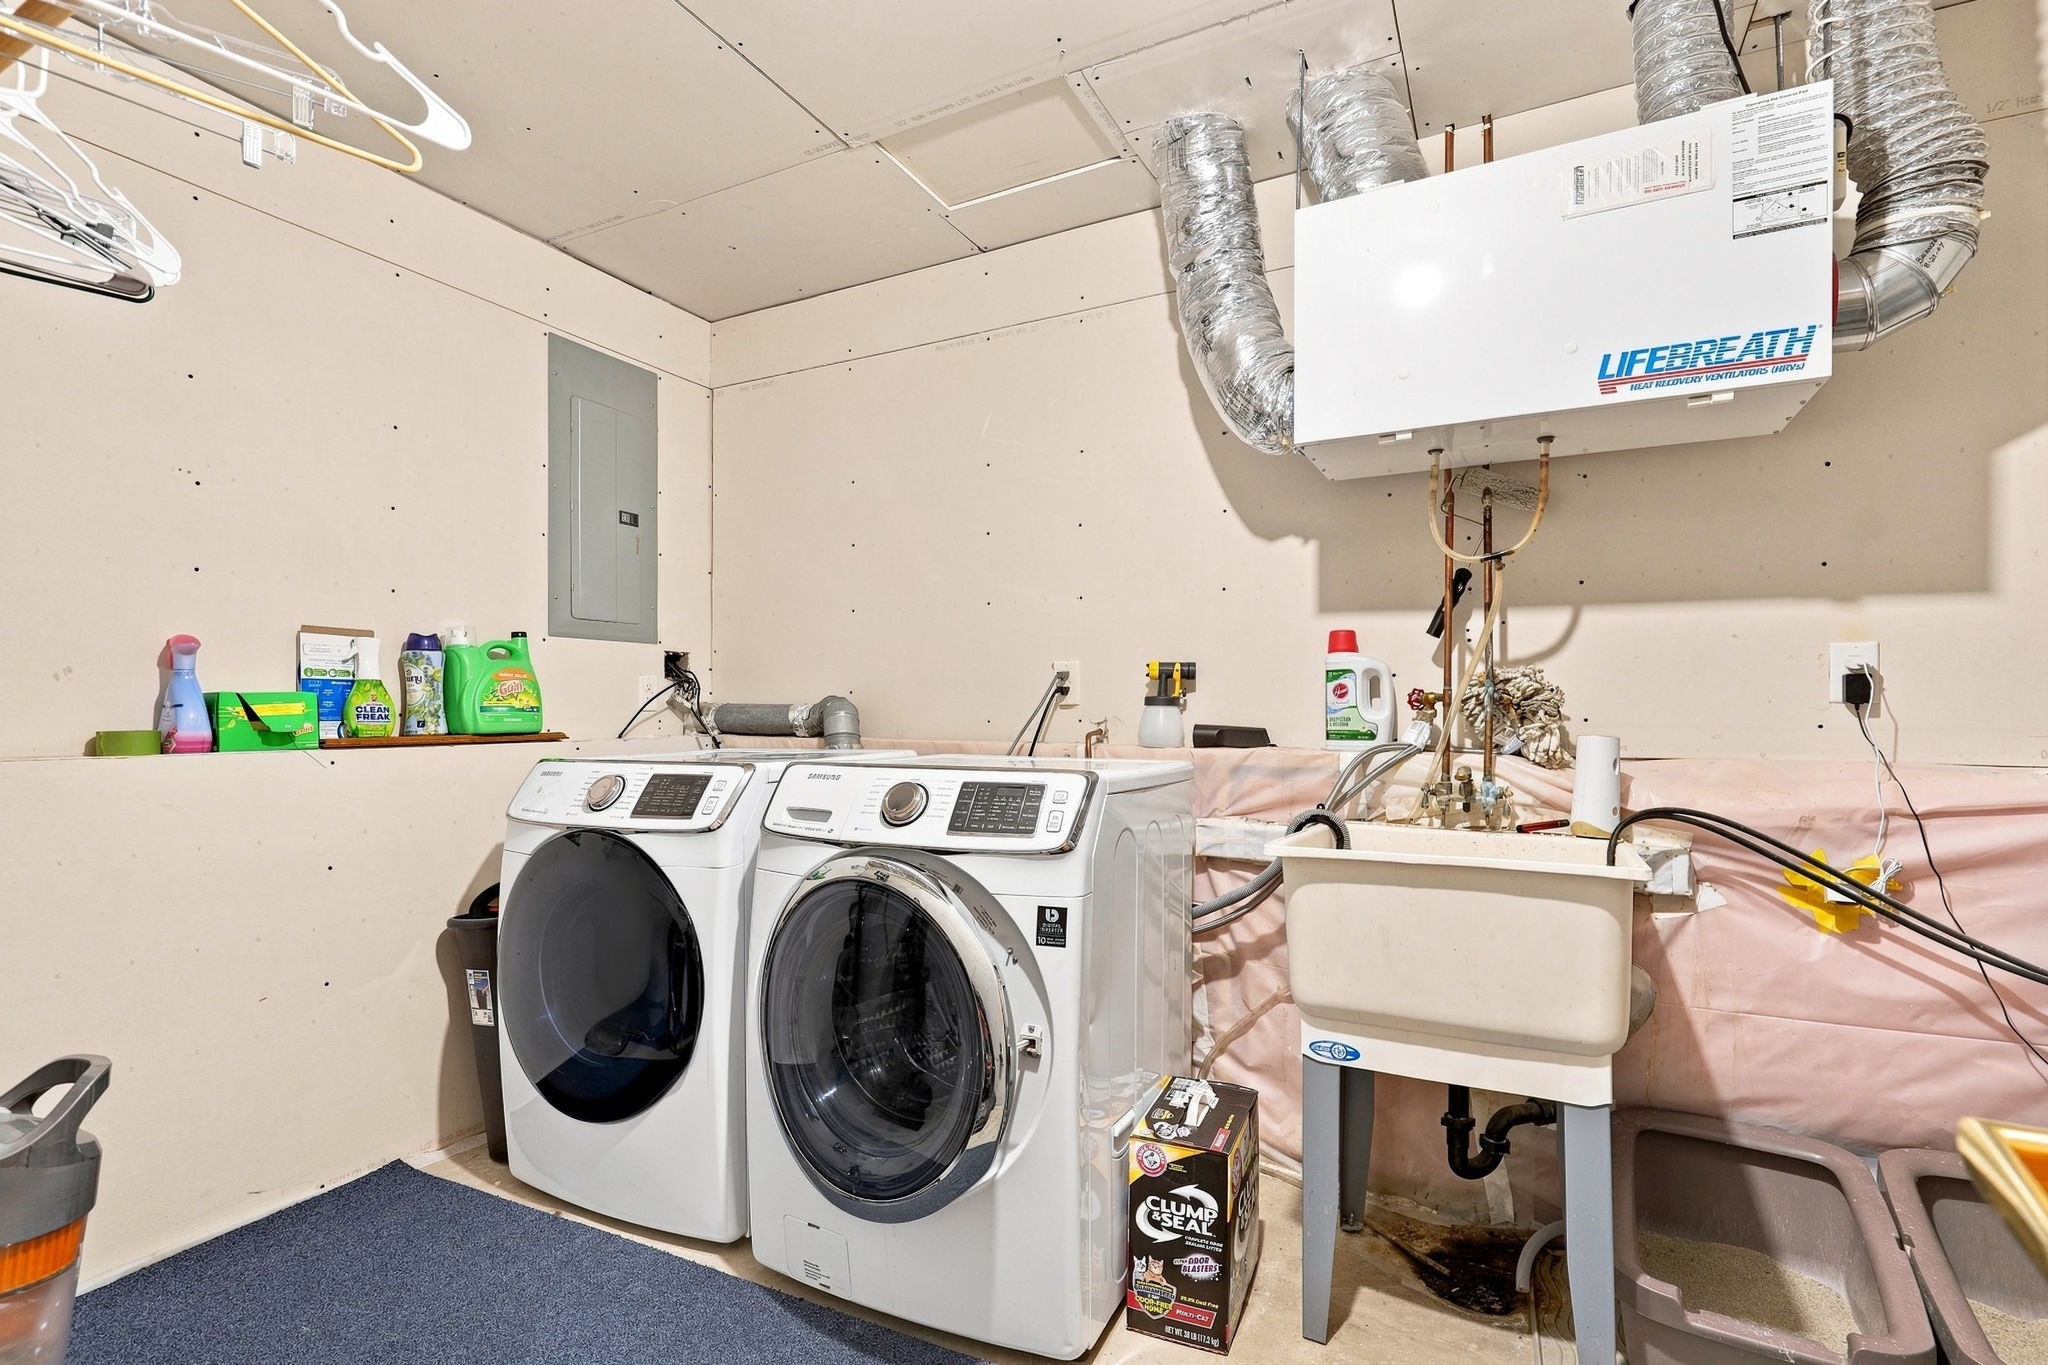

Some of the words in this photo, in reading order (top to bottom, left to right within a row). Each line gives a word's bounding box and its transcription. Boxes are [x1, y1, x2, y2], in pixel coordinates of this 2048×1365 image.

[1598, 324, 1817, 380] LIFEBREATH
[1630, 381, 1654, 392] HEAT
[1655, 375, 1704, 389] RECOVERY
[1705, 367, 1768, 382] VENTILATORS
[498, 681, 524, 697] Gain
[355, 706, 390, 714] CLEAN
[356, 713, 390, 721] FREAK
[808, 773, 842, 781] SAMSUNG
[1038, 936, 1047, 944] 10
[1146, 1195, 1218, 1222] CLUMP
[1161, 1213, 1213, 1237] SEAL
[1184, 1235, 1209, 1245] COMPLETE
[1185, 1240, 1205, 1249] SEALING
[1206, 1245, 1223, 1253] LITTER
[1188, 1256, 1210, 1265] ODOR
[1182, 1264, 1218, 1273] BLASTERS
[1195, 1298, 1207, 1306] Dust
[1144, 1304, 1164, 1314] HOME
[1165, 1325, 1175, 1334] NET
[1190, 1331, 1198, 1341] LB
